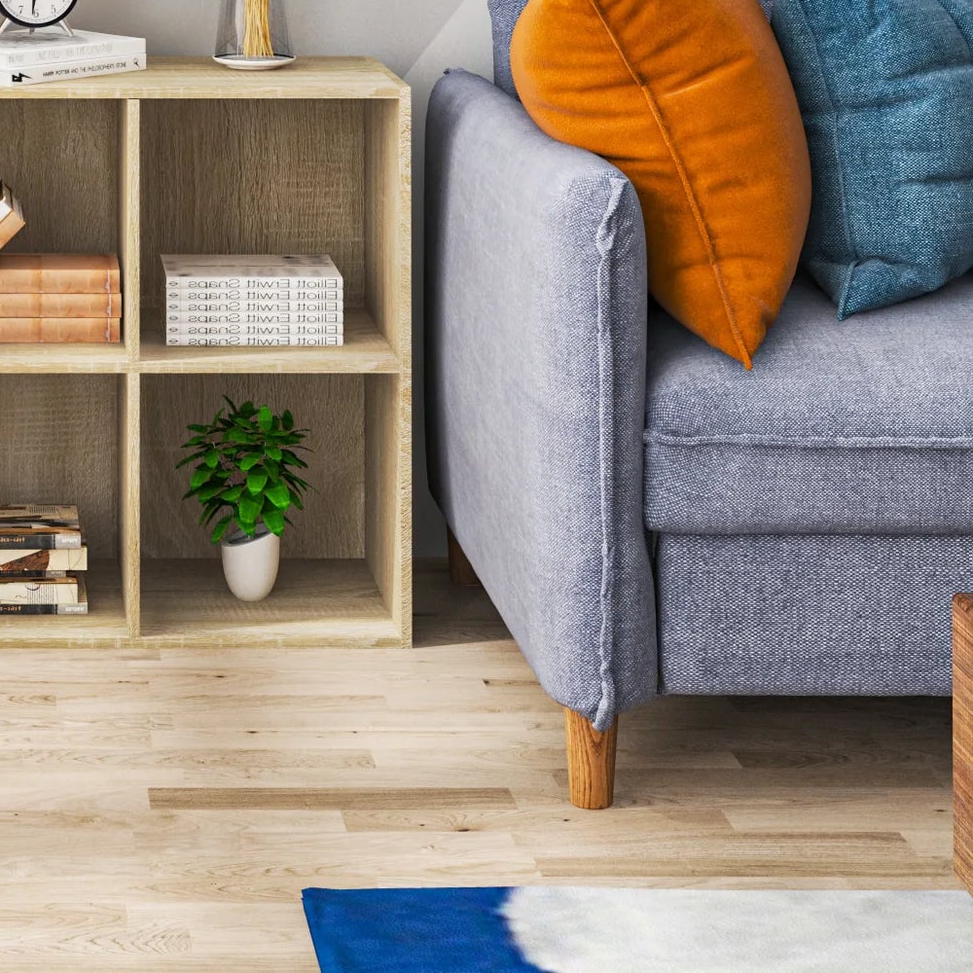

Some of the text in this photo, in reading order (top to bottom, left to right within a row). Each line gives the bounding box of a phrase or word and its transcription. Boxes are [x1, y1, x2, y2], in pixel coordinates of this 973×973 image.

[19, 6, 24, 14] 7
[33, 9, 39, 17] 6
[51, 5, 56, 13] 5
